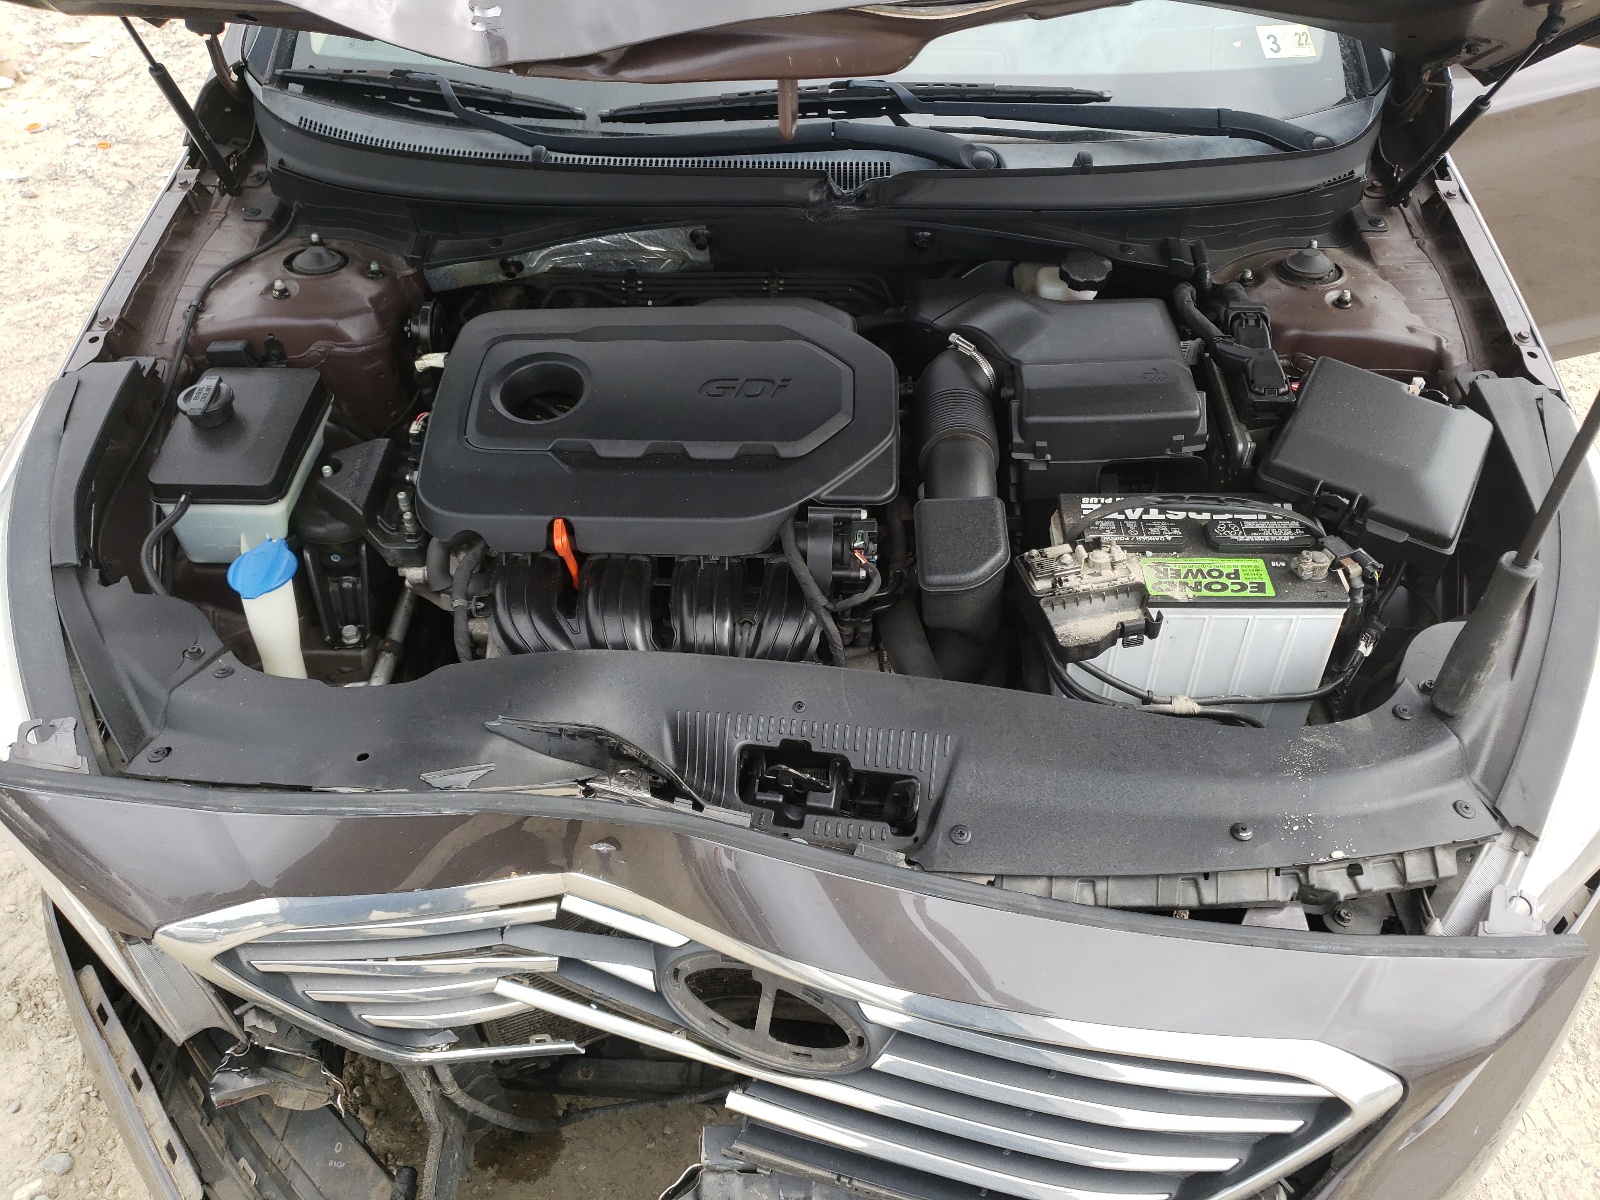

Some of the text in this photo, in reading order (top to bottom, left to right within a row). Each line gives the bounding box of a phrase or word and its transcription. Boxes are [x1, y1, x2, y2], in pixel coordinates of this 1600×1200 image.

[1266, 31, 1312, 54] 3 22
[1154, 568, 1241, 581] POWER
[1151, 581, 1267, 594] ECONO
